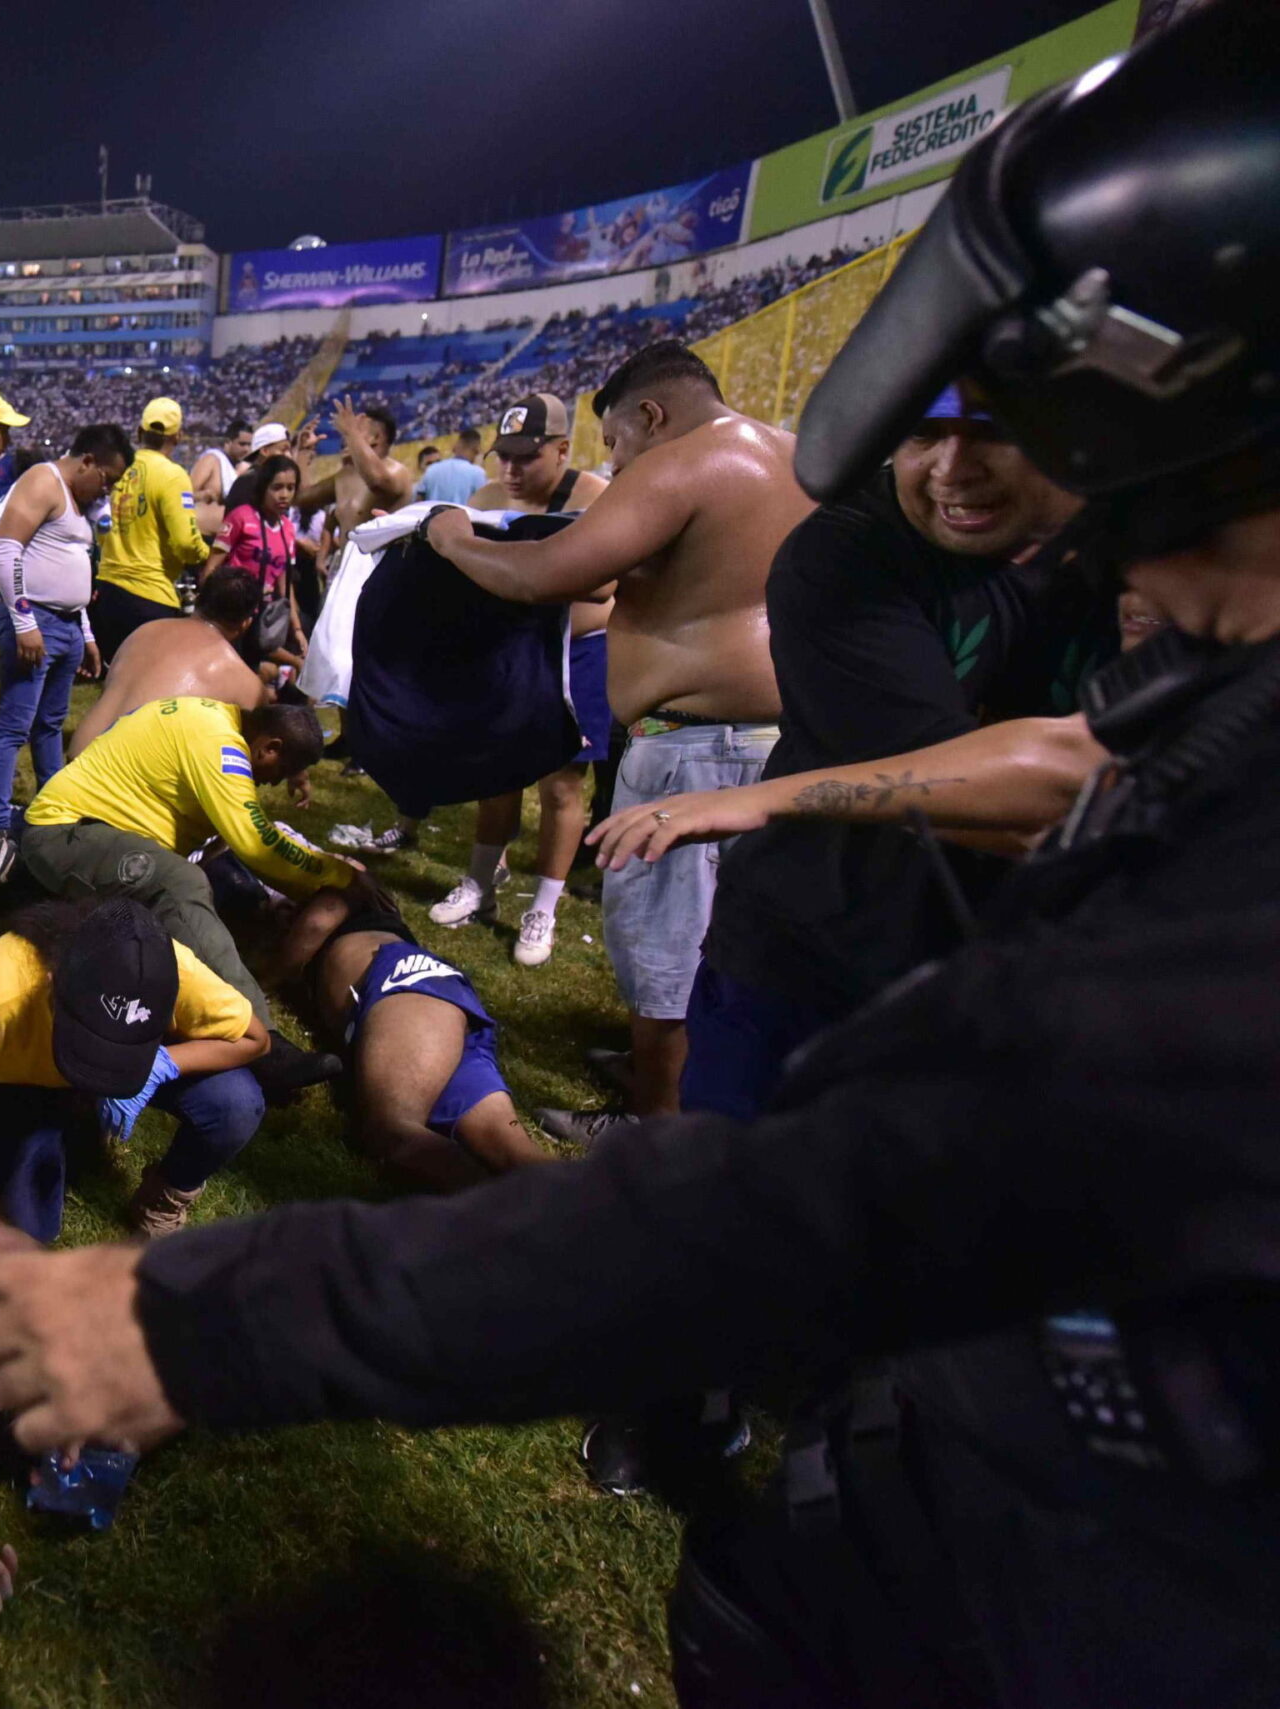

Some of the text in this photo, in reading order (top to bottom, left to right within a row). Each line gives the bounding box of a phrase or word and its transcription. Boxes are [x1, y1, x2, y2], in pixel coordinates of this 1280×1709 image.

[892, 94, 977, 146] SISTEMA
[461, 252, 481, 269] La
[483, 243, 514, 266] Red
[262, 262, 427, 291] SHERWIN-WILLIAMS
